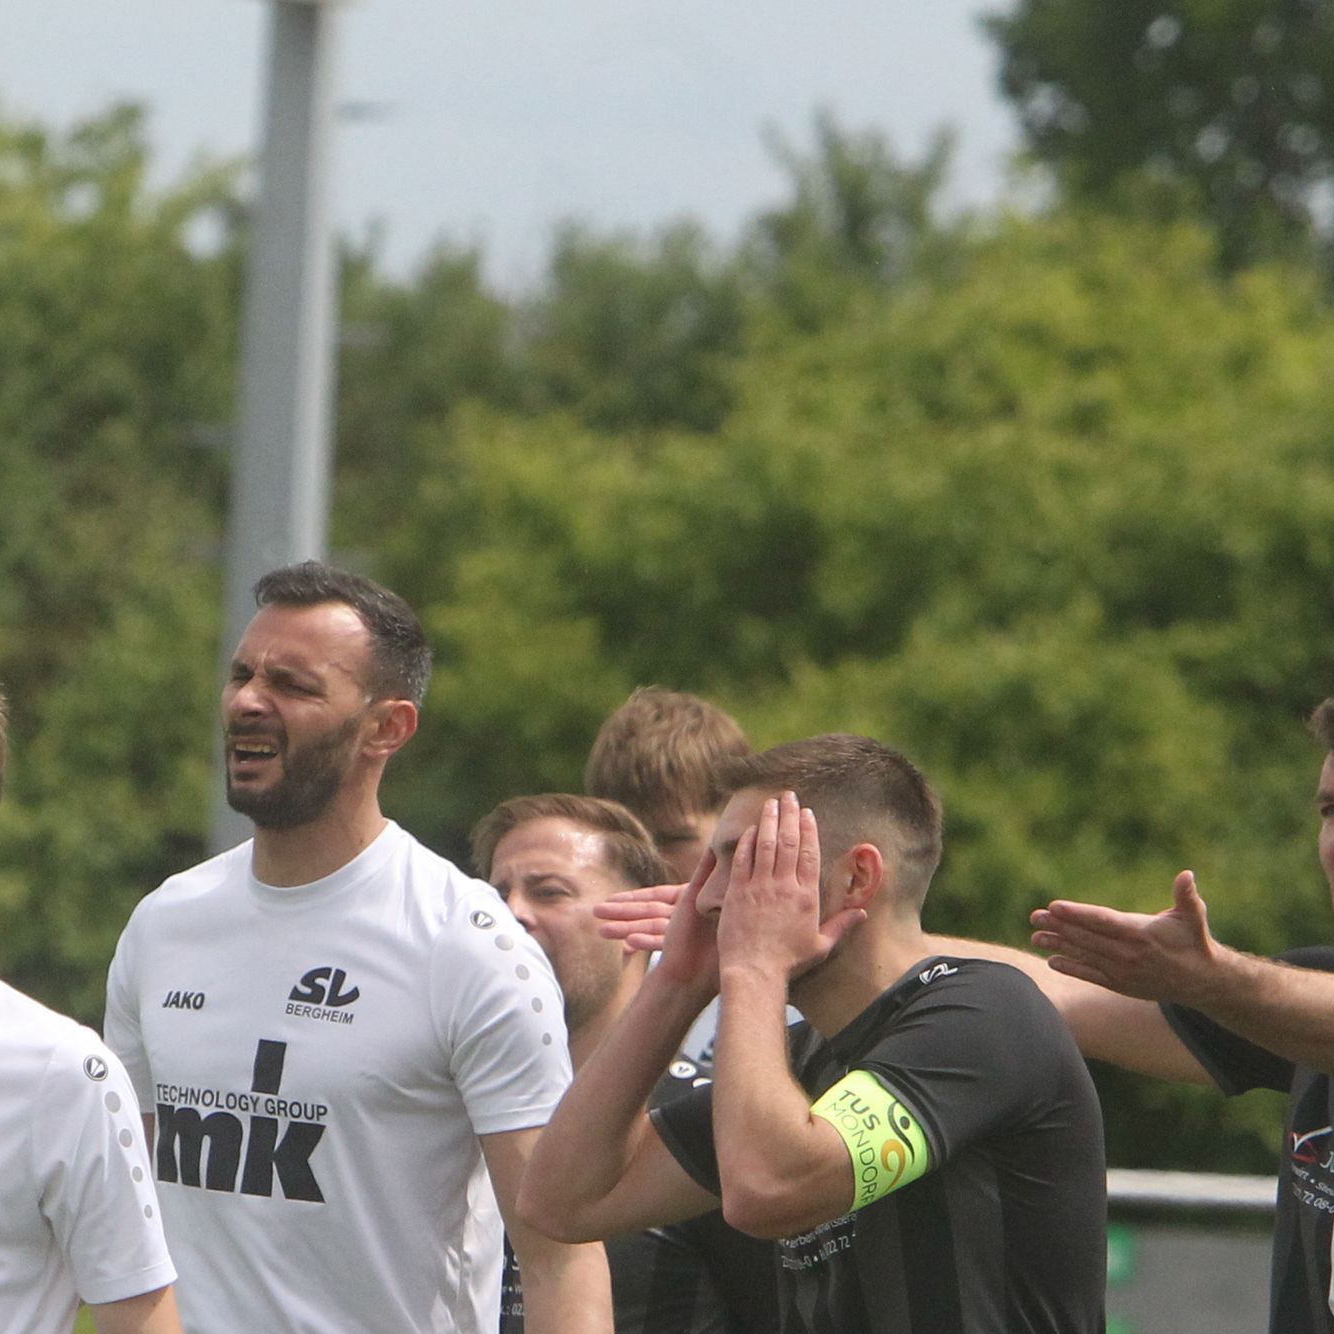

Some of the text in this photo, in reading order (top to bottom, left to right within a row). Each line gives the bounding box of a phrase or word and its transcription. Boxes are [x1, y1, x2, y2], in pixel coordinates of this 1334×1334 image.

[163, 990, 205, 1010] JAKO
[285, 1003, 354, 1025] BERGHEIM
[156, 1083, 328, 1121] TECHNOLOGY GROUP
[838, 1089, 881, 1132] TUS
